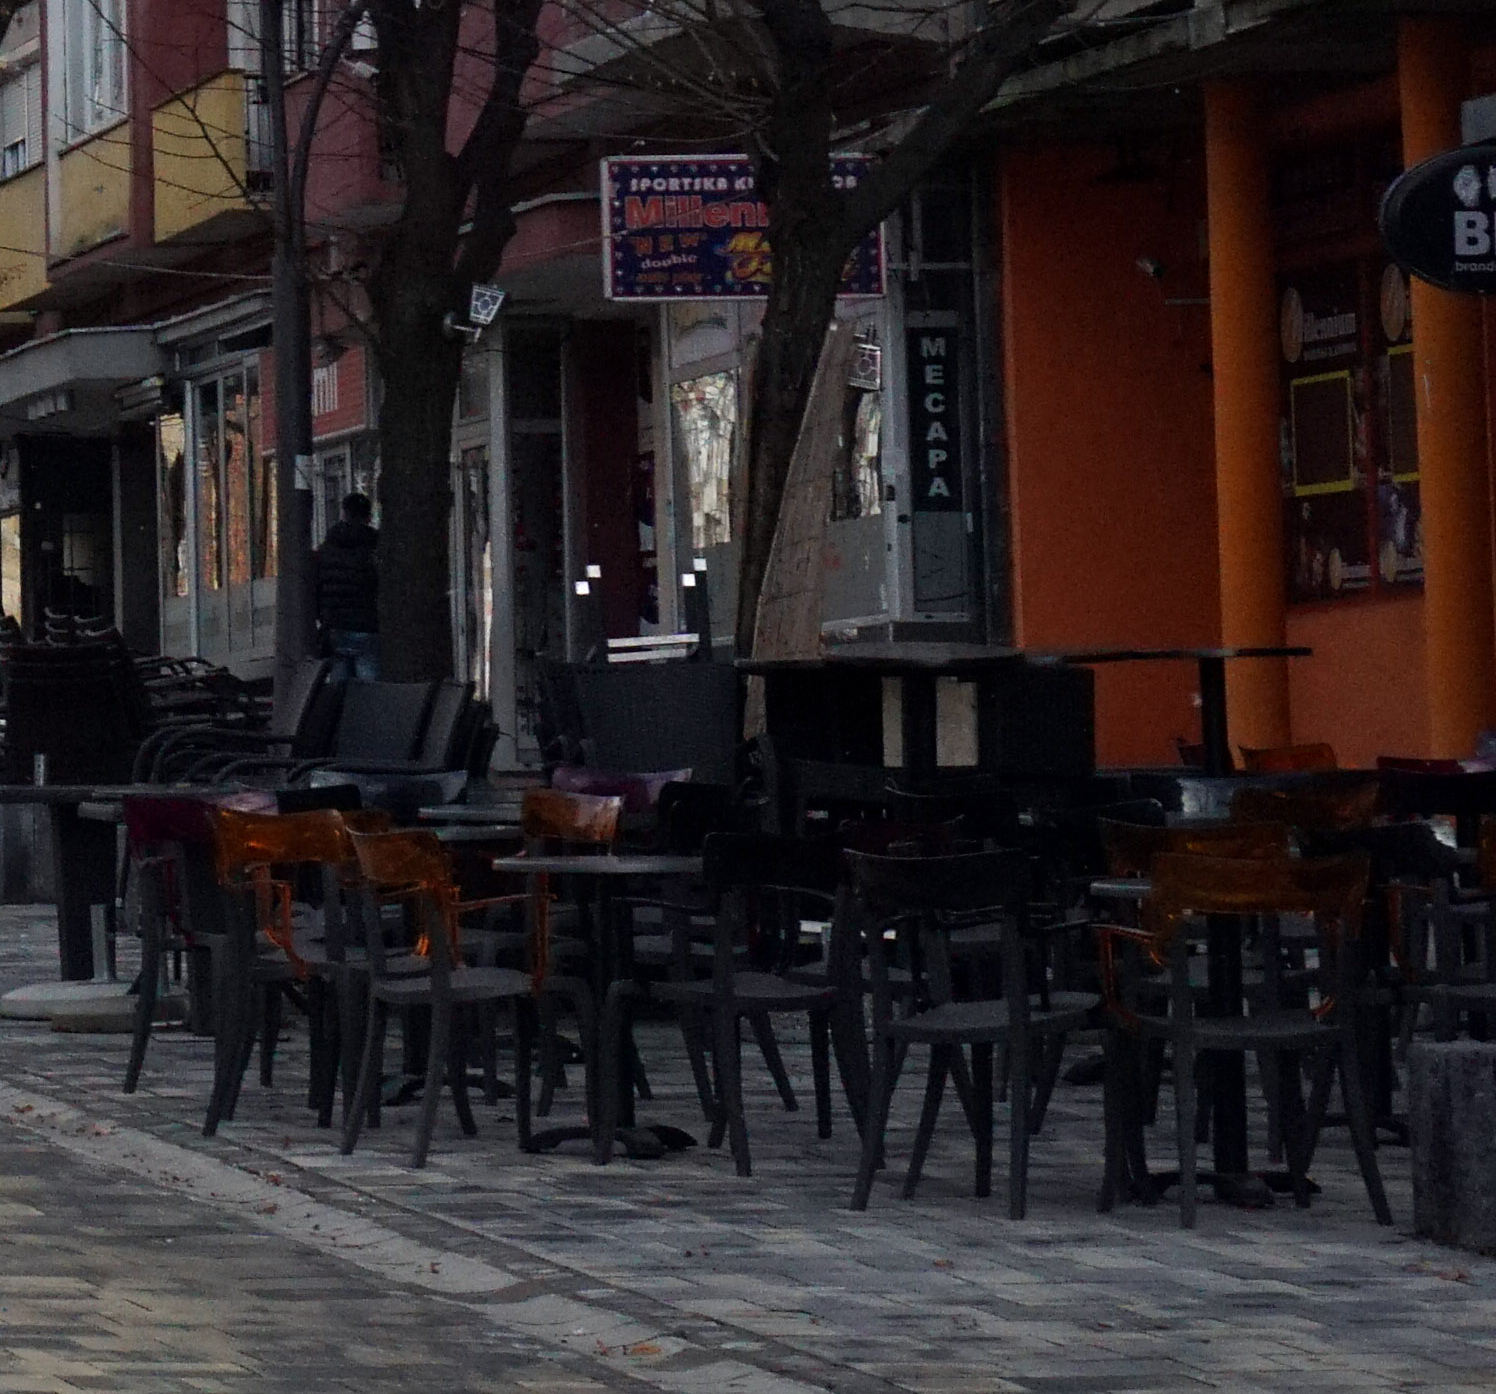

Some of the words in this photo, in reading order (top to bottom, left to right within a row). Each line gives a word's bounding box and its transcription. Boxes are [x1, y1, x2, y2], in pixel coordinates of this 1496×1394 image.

[630, 177, 728, 192] SPORTSKA
[625, 195, 769, 228] Millen
[1454, 211, 1496, 256] B
